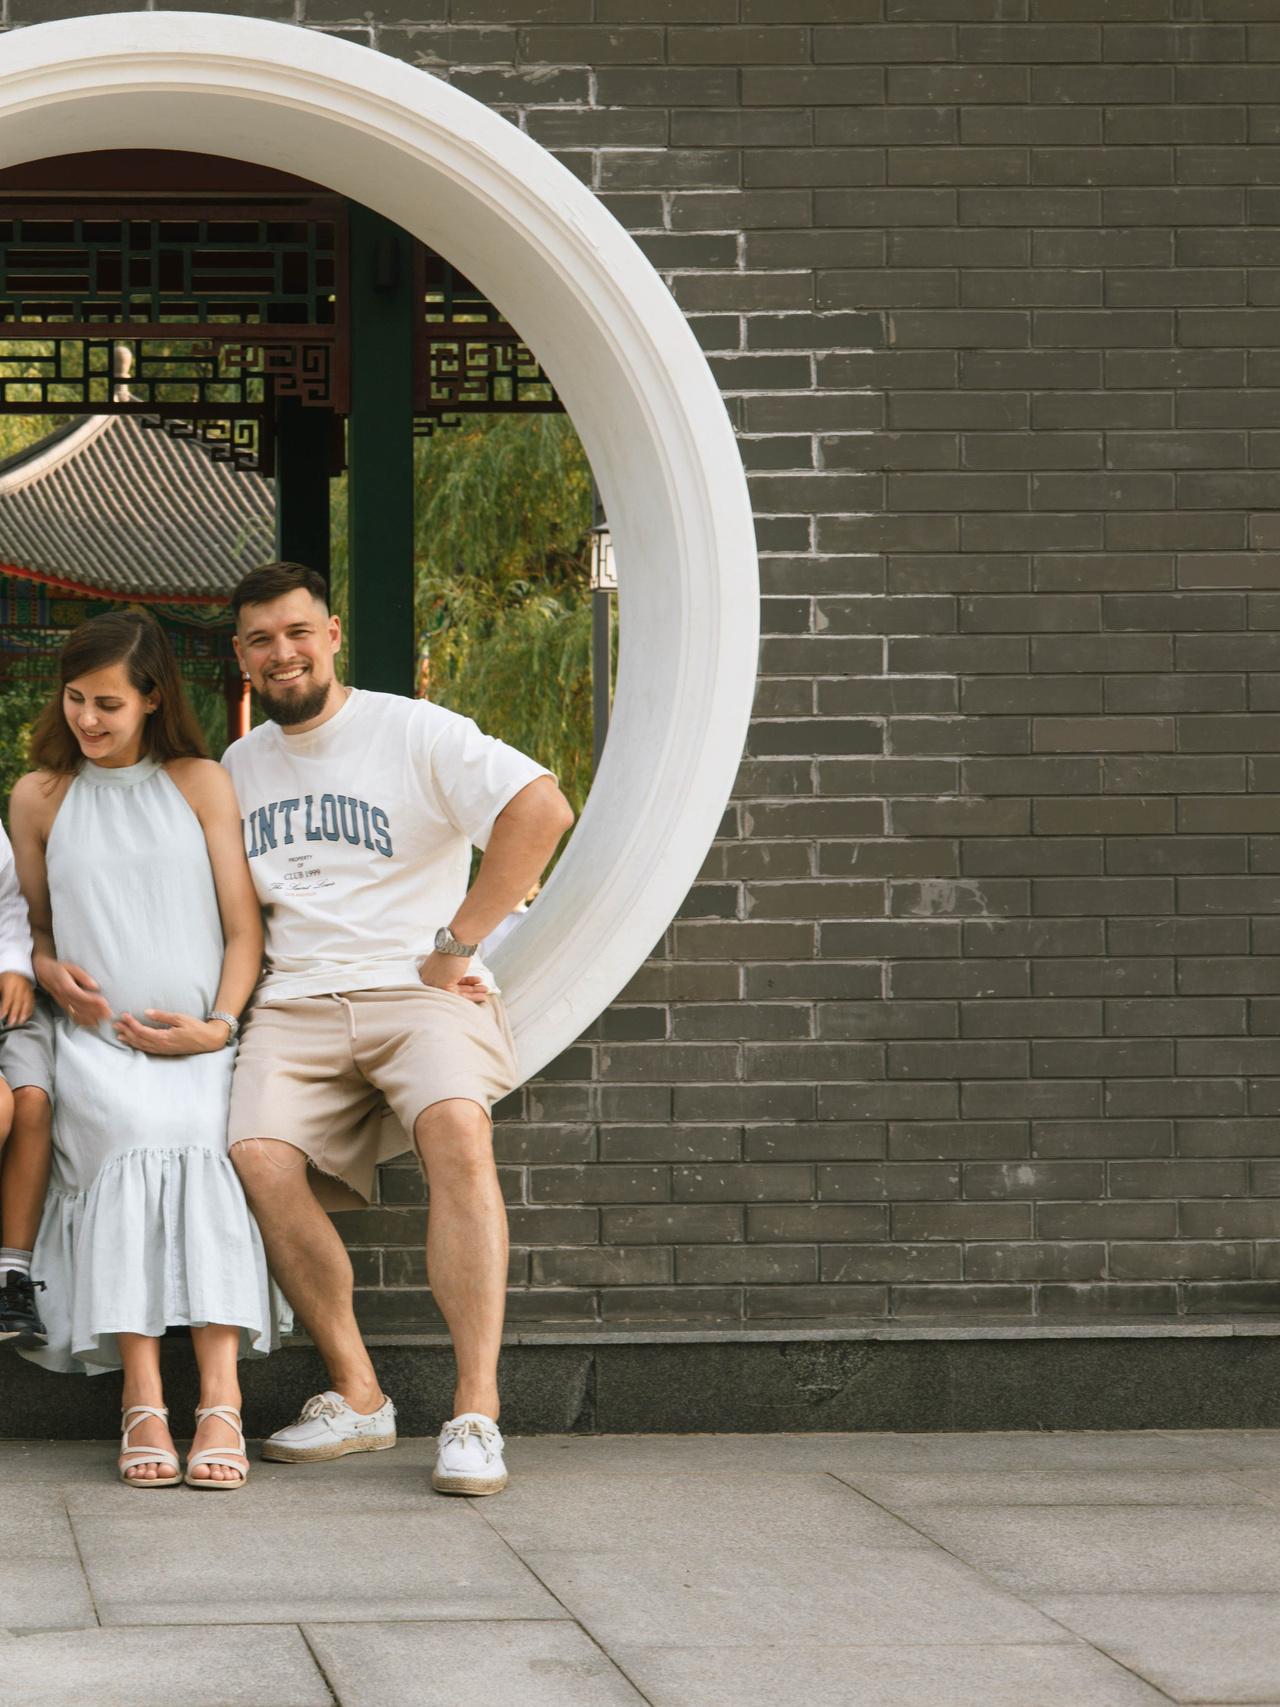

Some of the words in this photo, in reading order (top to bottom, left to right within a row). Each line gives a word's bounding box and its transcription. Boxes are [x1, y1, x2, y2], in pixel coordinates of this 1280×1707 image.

[241, 798, 300, 858] INT
[305, 794, 393, 858] LOUIS
[288, 854, 313, 862] PROPERTY
[284, 871, 304, 880] CLUB
[305, 868, 321, 877] 1999
